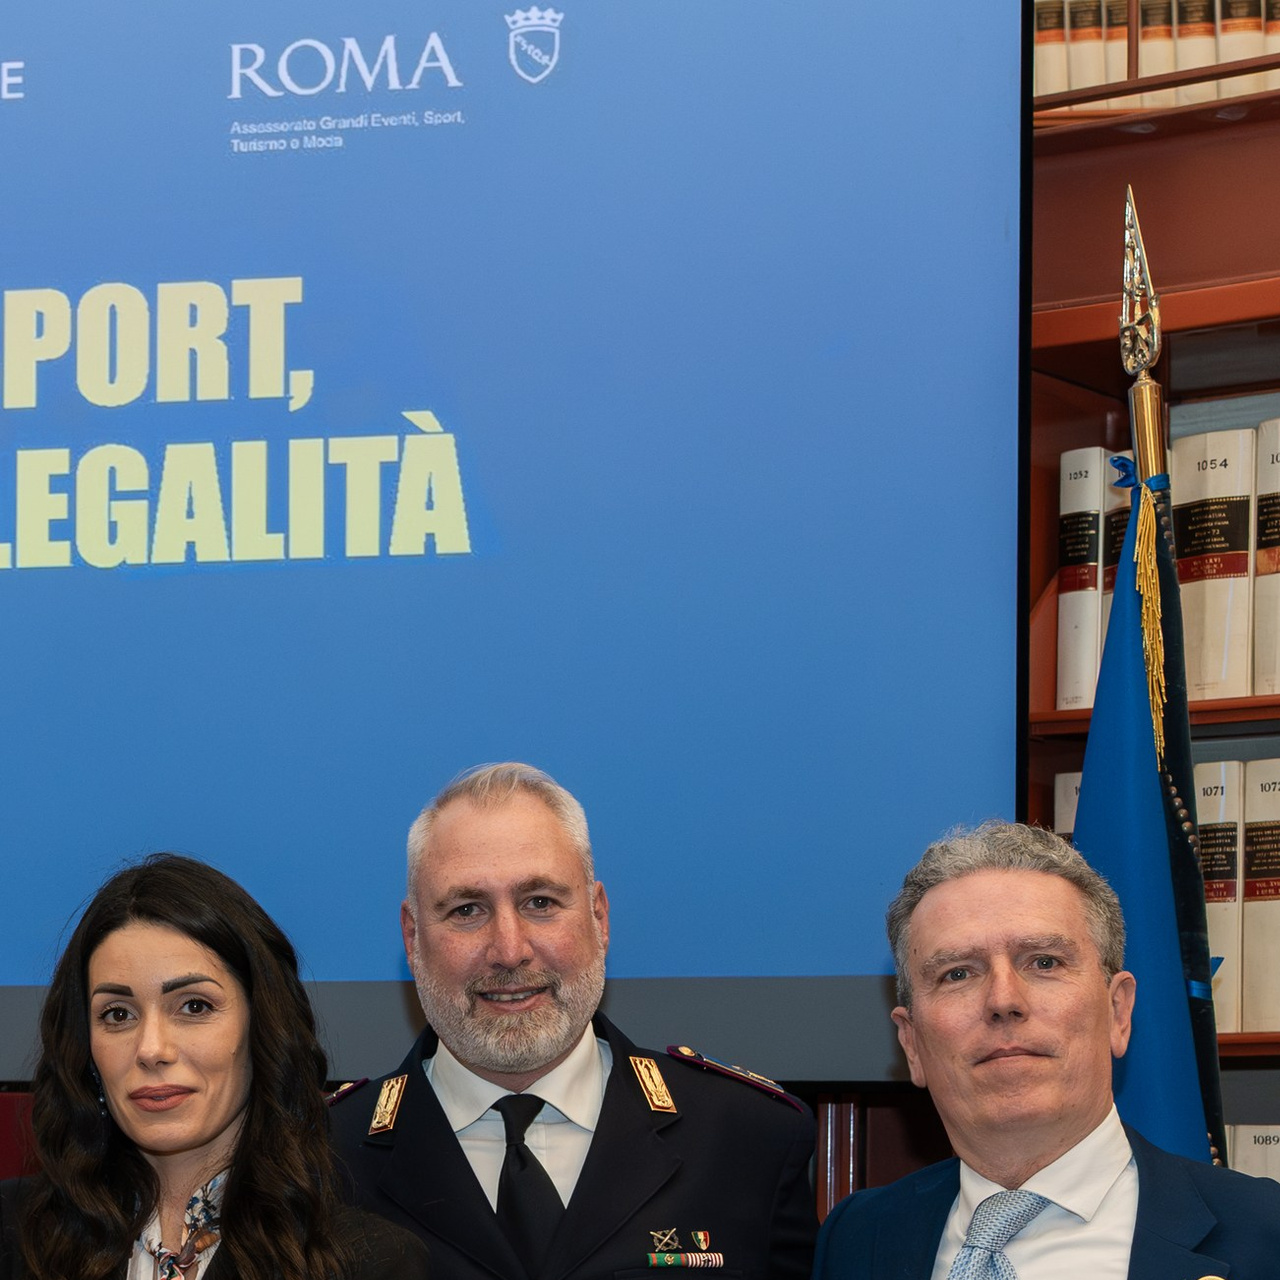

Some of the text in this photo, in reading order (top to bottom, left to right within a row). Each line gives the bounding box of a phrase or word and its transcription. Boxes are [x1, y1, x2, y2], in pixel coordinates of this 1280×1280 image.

[226, 31, 464, 99] ROMA
[230, 110, 466, 135] Assessorato Grandi Eventi, Sport,
[230, 134, 344, 152] Turismo e Moda
[1197, 458, 1229, 471] 1054
[1069, 470, 1089, 480] 1052
[1202, 786, 1225, 797] 1071
[1253, 1135, 1280, 1145] 1089
